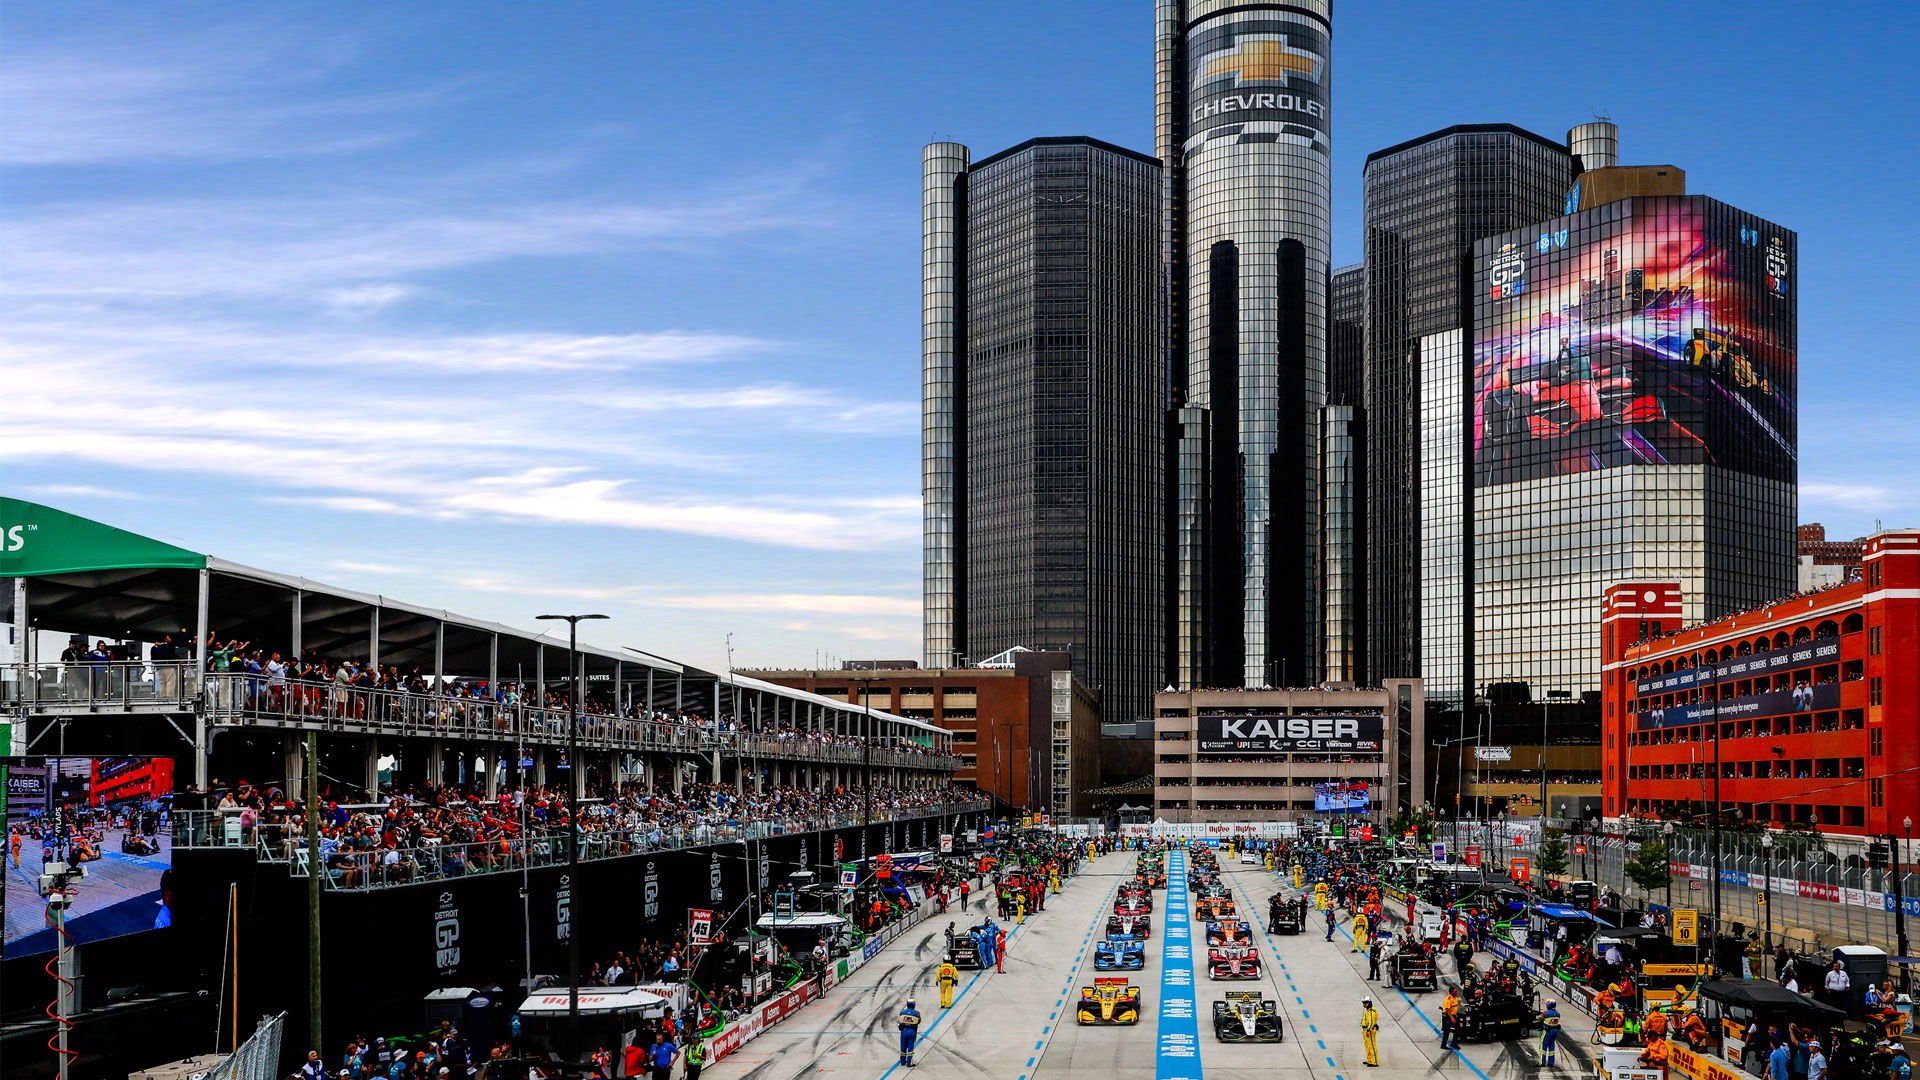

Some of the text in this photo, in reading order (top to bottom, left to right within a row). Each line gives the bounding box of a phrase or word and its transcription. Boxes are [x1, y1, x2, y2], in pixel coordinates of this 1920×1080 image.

[1193, 93, 1326, 122] CHEVROLET
[1490, 252, 1525, 266] DETROIT
[0, 525, 24, 551] s
[1665, 678, 1678, 687] SIEMENS
[1680, 674, 1694, 684] SIEMENS
[1730, 664, 1747, 674] SIEMENS
[1750, 659, 1767, 670] SIEMENS
[1770, 655, 1788, 666] SIEMENS
[1792, 650, 1811, 662] SIEMENS
[1816, 644, 1837, 657] SIEMENS
[1687, 710, 1702, 718] Technoloy
[1221, 719, 1359, 739] KAISER
[1236, 741, 1250, 749] UPI
[1296, 740, 1321, 748] CCI
[1208, 826, 1230, 834] HyVee
[1235, 826, 1257, 834] HyVee
[1517, 870, 1522, 879] 9
[556, 890, 570, 899] DETRO
[645, 881, 658, 903] GP
[434, 909, 459, 920] DETROIT
[435, 918, 460, 949] GP
[693, 922, 709, 937] 45
[1679, 928, 1690, 939] 10
[766, 1005, 780, 1021] Astemo
[1889, 1024, 1900, 1036] 10
[715, 1039, 728, 1057] HyVee
[1673, 1047, 1697, 1074] DHL
